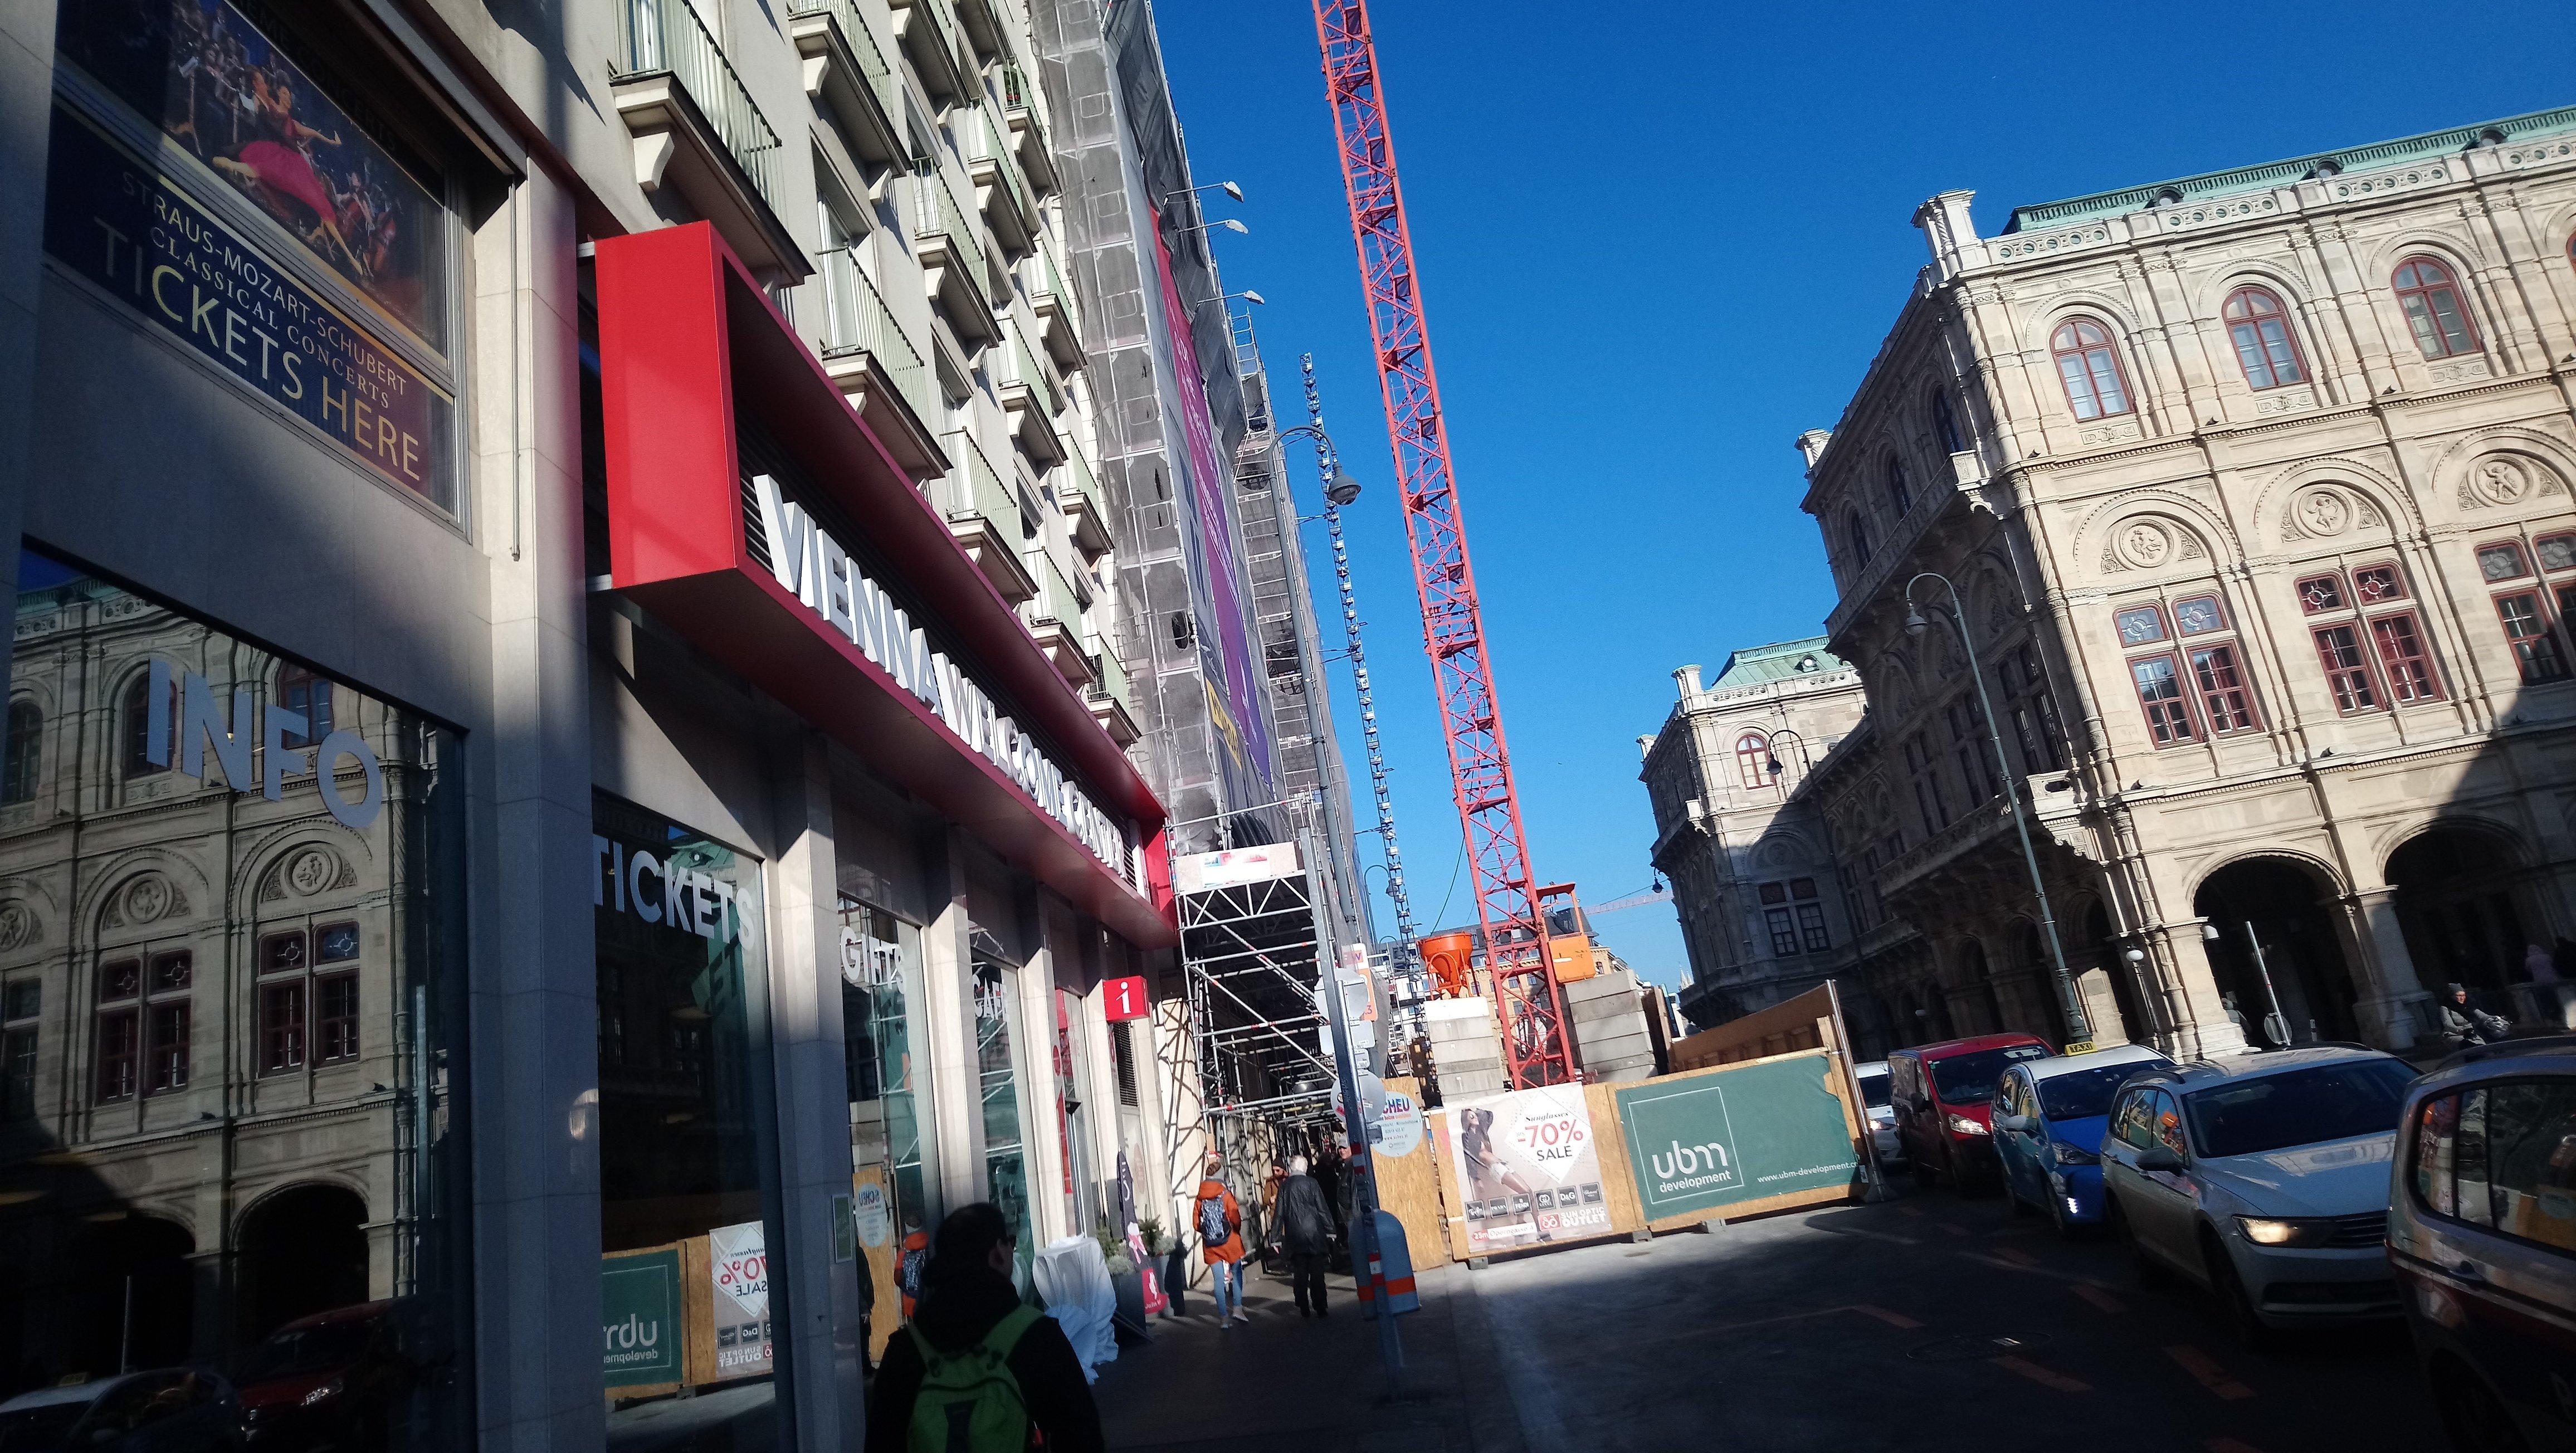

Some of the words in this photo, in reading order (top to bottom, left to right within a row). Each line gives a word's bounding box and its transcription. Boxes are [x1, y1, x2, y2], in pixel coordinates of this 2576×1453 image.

[122, 171, 406, 397] STRAUS-MOZART-SCHUBERT
[150, 225, 279, 330] CLASSICAL
[288, 325, 390, 409] CONCERTS
[94, 216, 304, 399] TICKETS
[321, 377, 421, 482] HERE
[754, 474, 943, 720] VIENNA
[147, 658, 383, 828] INFO
[593, 833, 755, 952] TICKETS
[840, 925, 906, 995] GIFTS
[2069, 1042, 2092, 1052] TAXI
[1383, 1097, 1410, 1114] CHEU
[1525, 1111, 1569, 1123] Sunglasses
[1518, 1119, 1583, 1148] -70%
[1536, 1145, 1573, 1162] SALE
[1651, 1139, 1729, 1179] ubm
[1659, 1169, 1732, 1193] development
[1560, 1191, 1576, 1201] D&G
[1560, 1210, 1578, 1220] SUN
[1580, 1206, 1604, 1216] OPTIC
[1562, 1213, 1606, 1228] OUTLET
